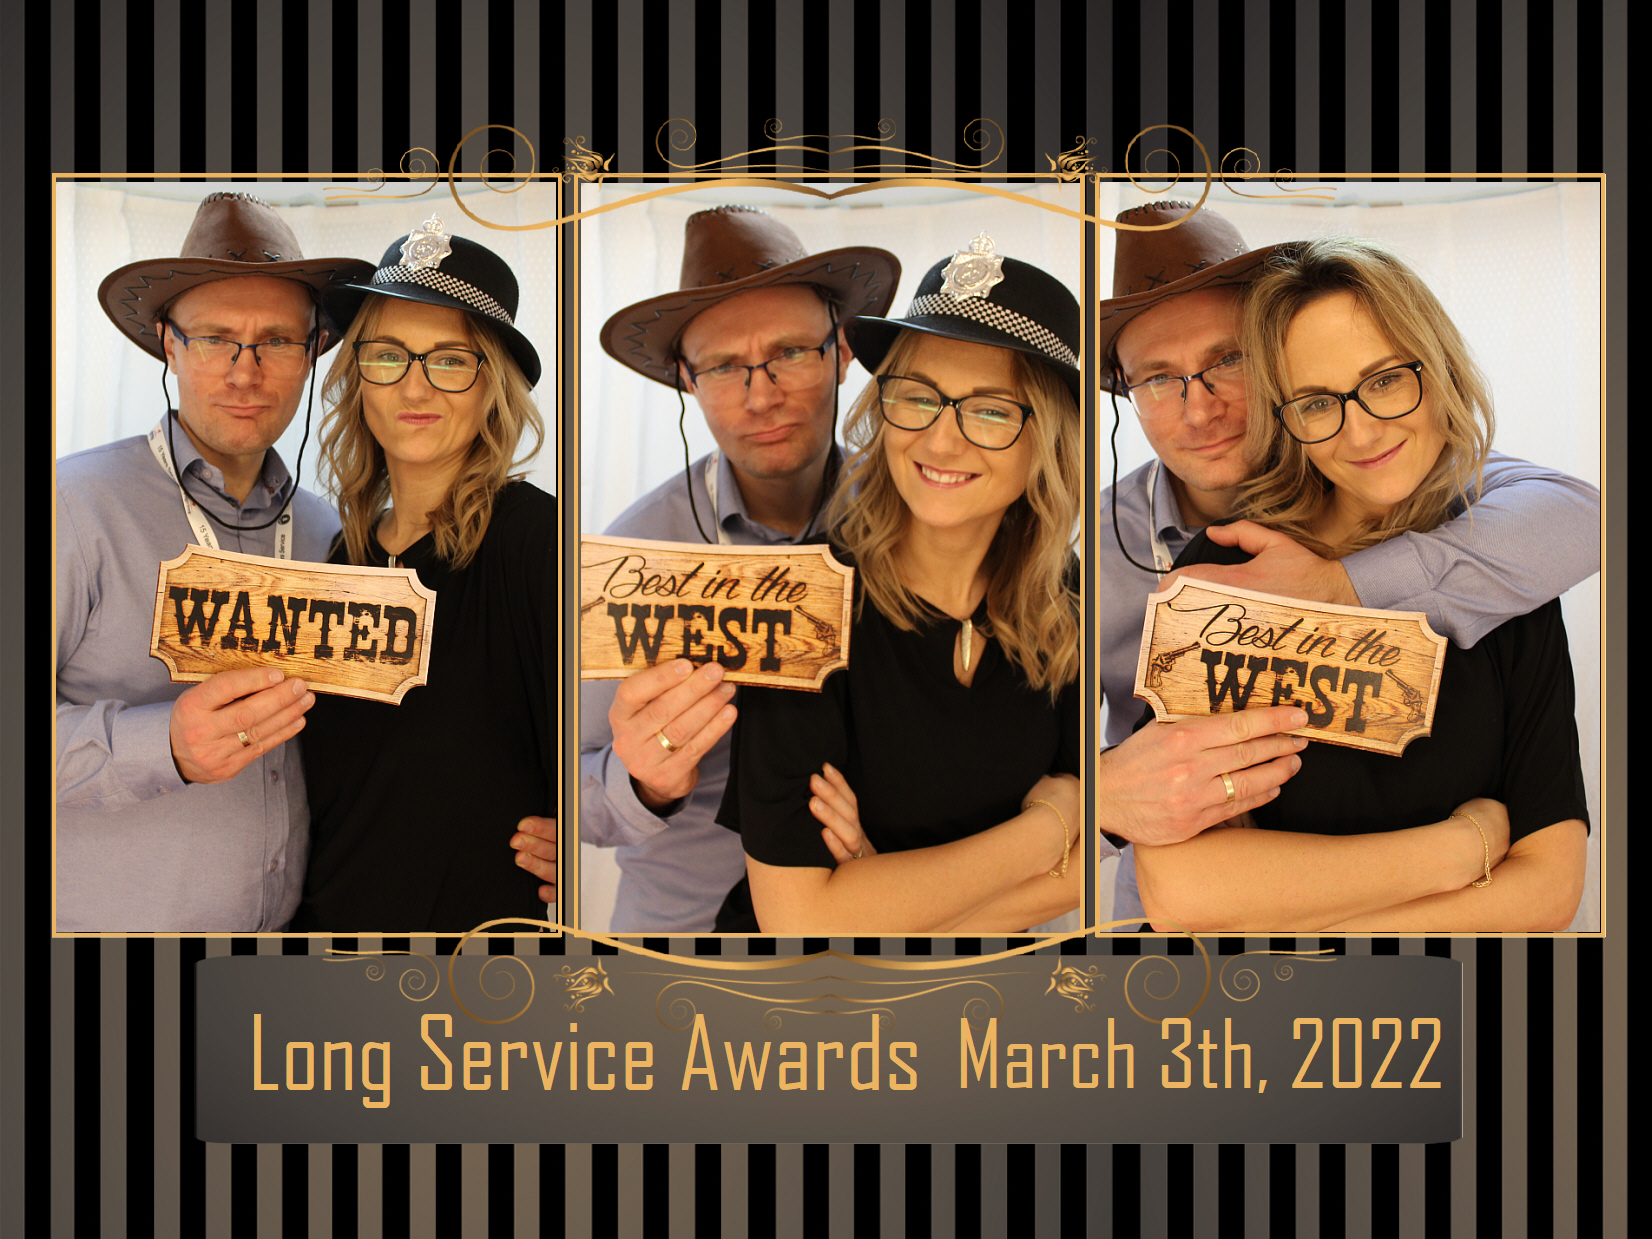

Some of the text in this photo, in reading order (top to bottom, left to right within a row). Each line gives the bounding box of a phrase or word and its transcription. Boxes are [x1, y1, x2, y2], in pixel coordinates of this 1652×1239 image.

[199, 524, 214, 549] 15 Year
[582, 554, 808, 604] Best in the
[169, 585, 418, 666] WANTED
[607, 602, 792, 672] WEST
[1167, 603, 1401, 667] Best in the
[1200, 649, 1384, 734] WEST
